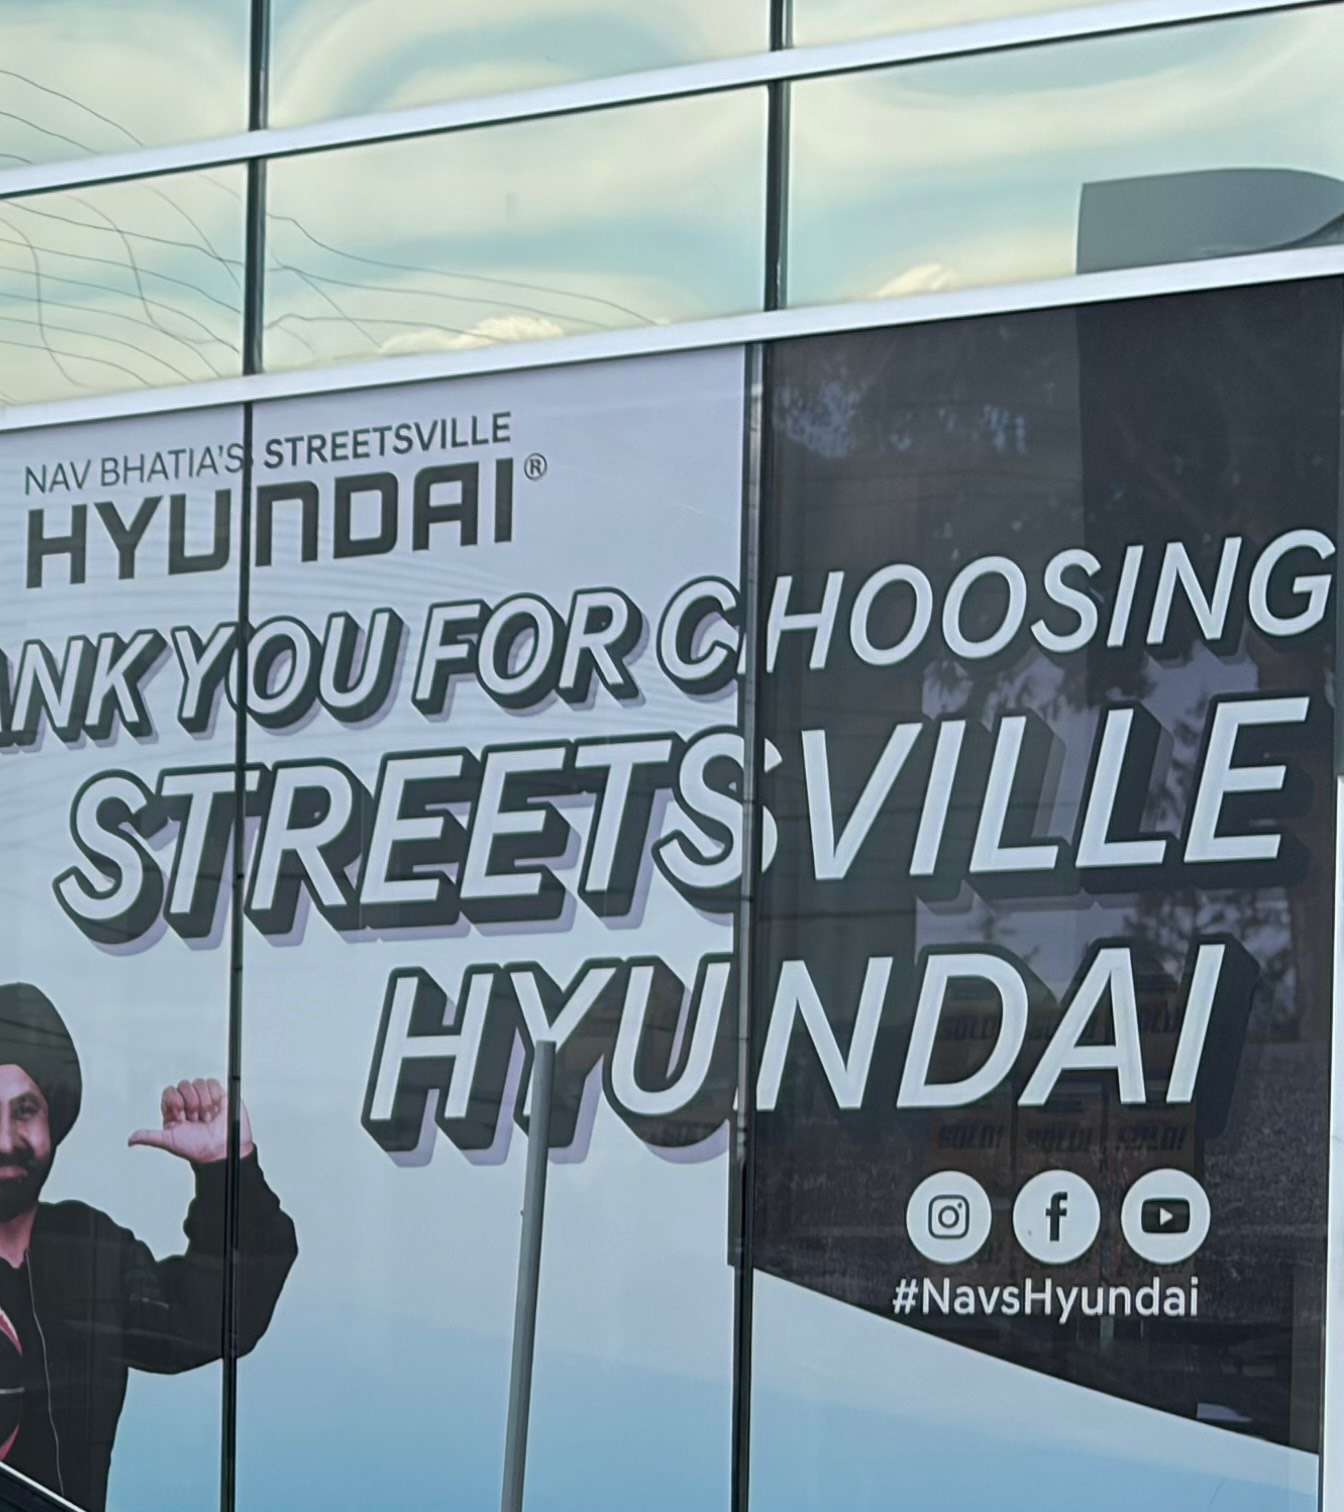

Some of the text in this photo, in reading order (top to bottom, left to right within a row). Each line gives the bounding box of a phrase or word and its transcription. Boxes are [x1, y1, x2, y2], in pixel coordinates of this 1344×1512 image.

[25, 411, 512, 495] NAV BHATIA'S STREETSVILLE
[26, 456, 513, 589] HYUNDAI
[172, 607, 407, 735] YOU
[413, 586, 642, 715] FOR
[657, 528, 1338, 690] CHOOSING
[53, 695, 1312, 943] STREETSVILLE
[360, 940, 1232, 1150] HYUNDAI
[893, 1275, 1200, 1324] #NavsHyundai
